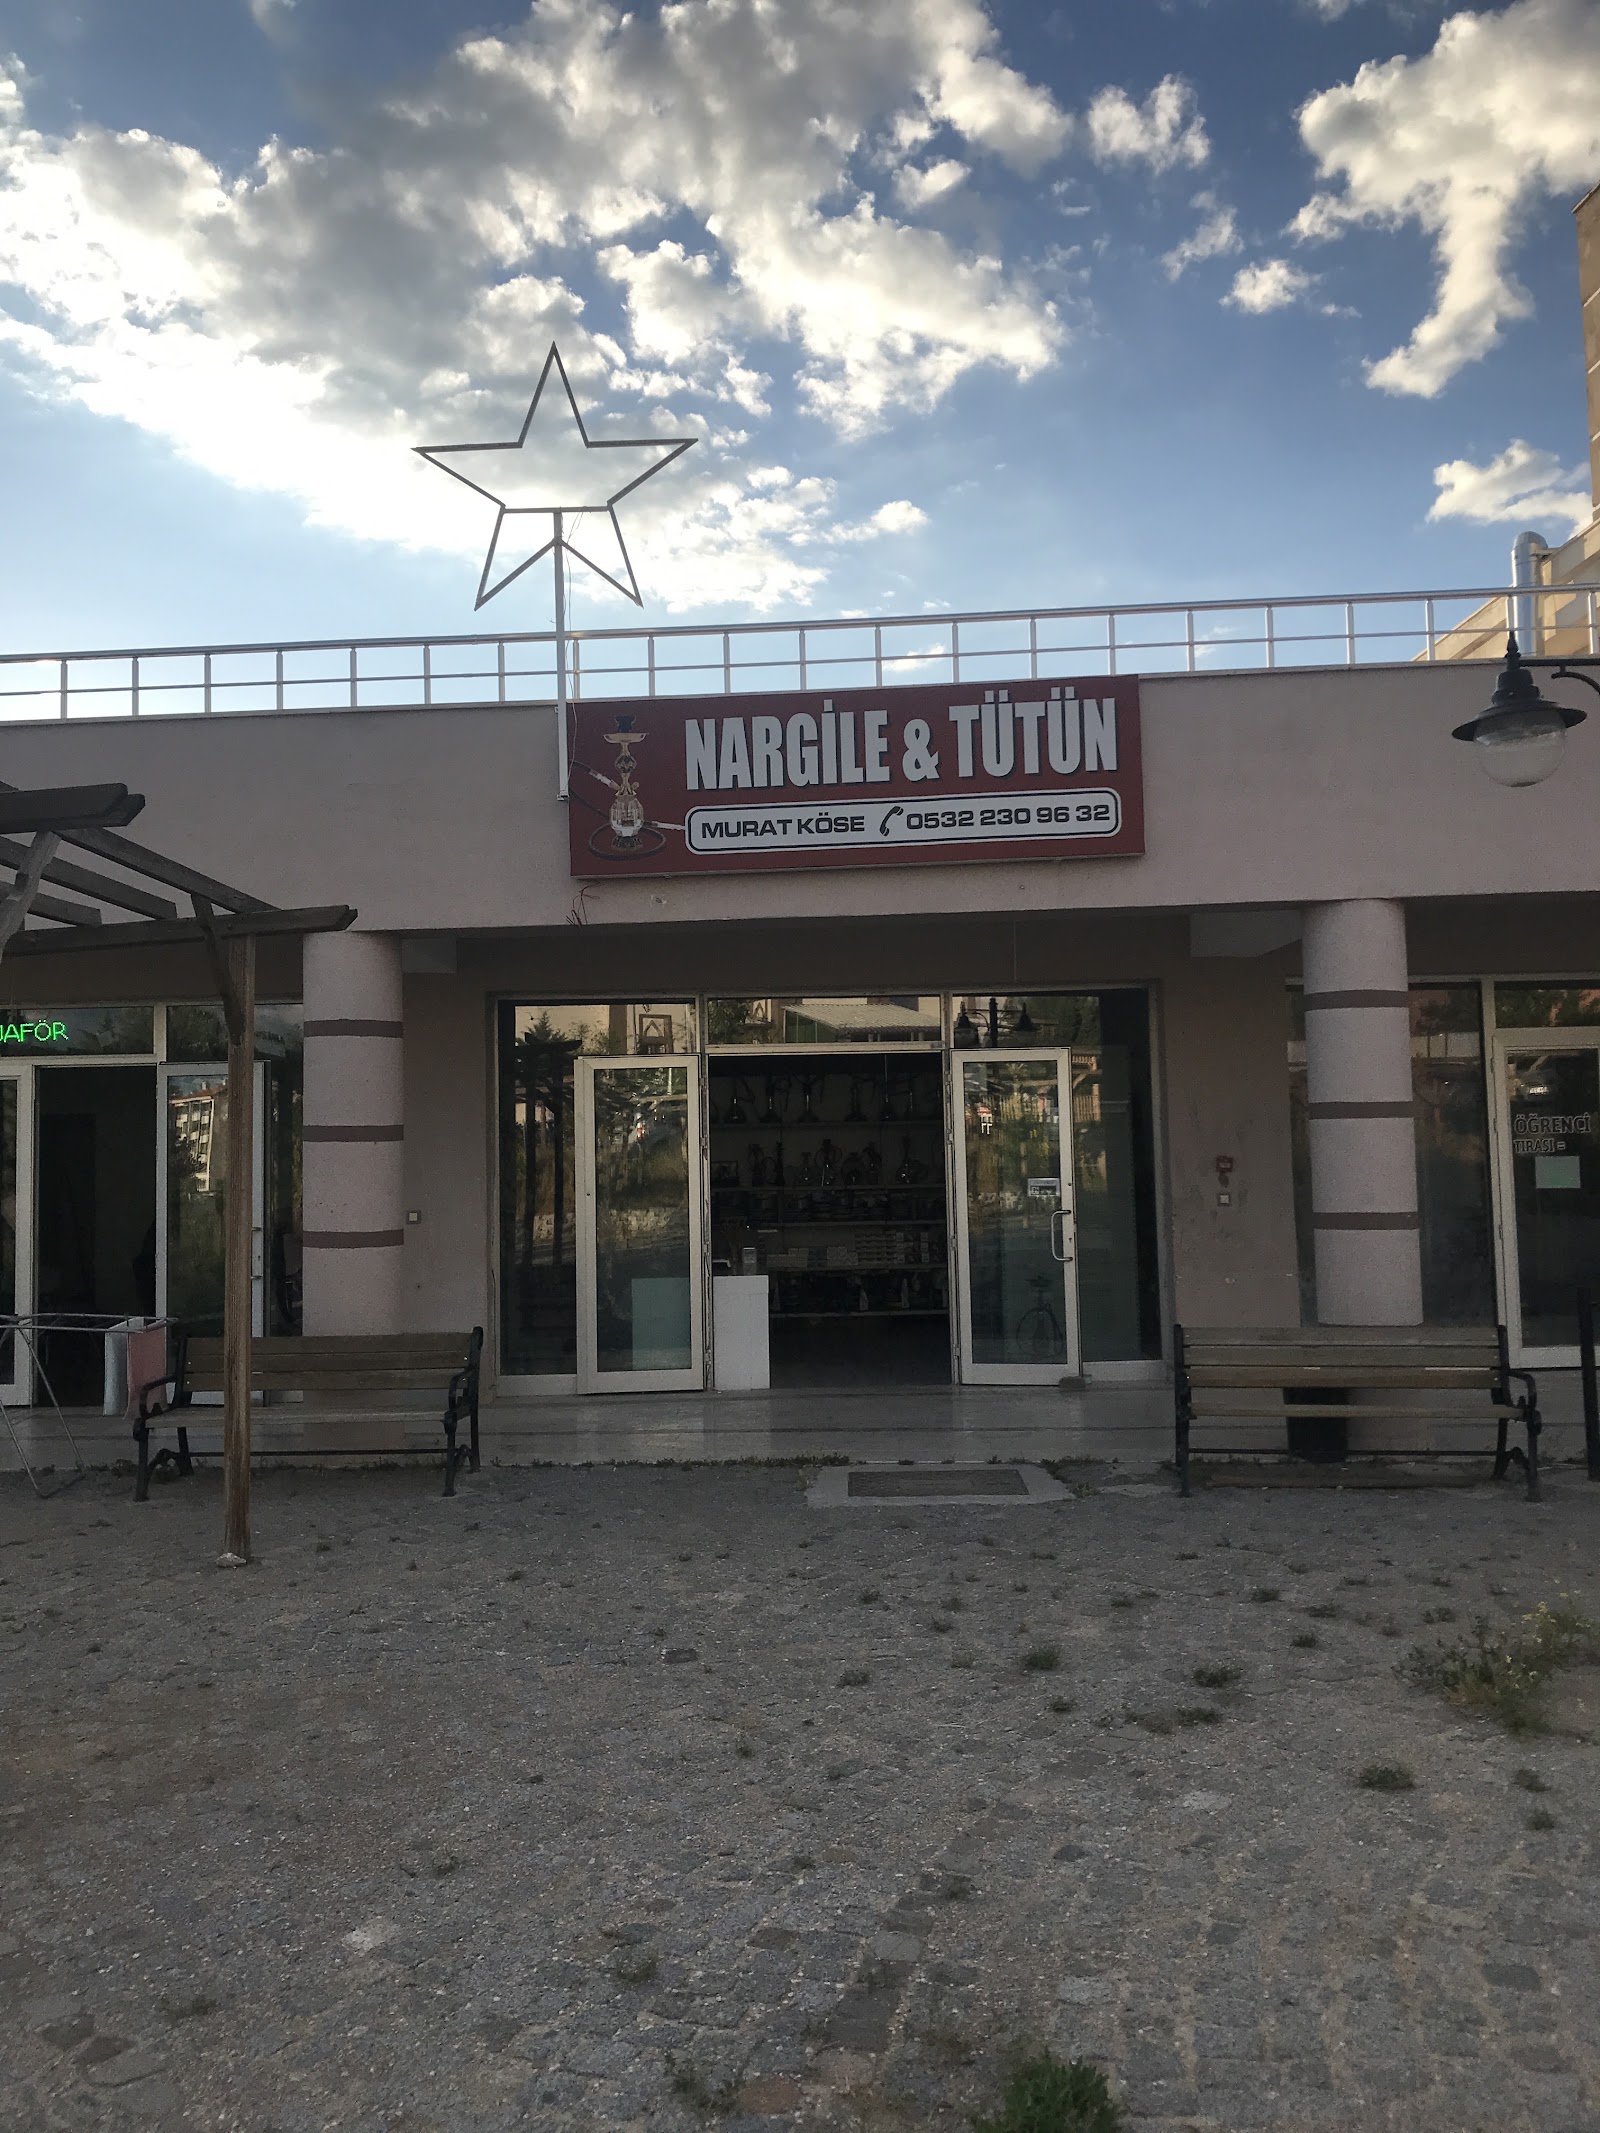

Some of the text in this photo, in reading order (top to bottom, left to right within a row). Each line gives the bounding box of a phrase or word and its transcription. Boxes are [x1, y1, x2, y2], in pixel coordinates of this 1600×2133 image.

[685, 686, 1118, 790] NARGİLE & TÜTÜN
[701, 804, 1110, 838] MURAT KÖSE 0532 230 96 32
[1514, 1112, 1591, 1135] ÖĞRENCİ
